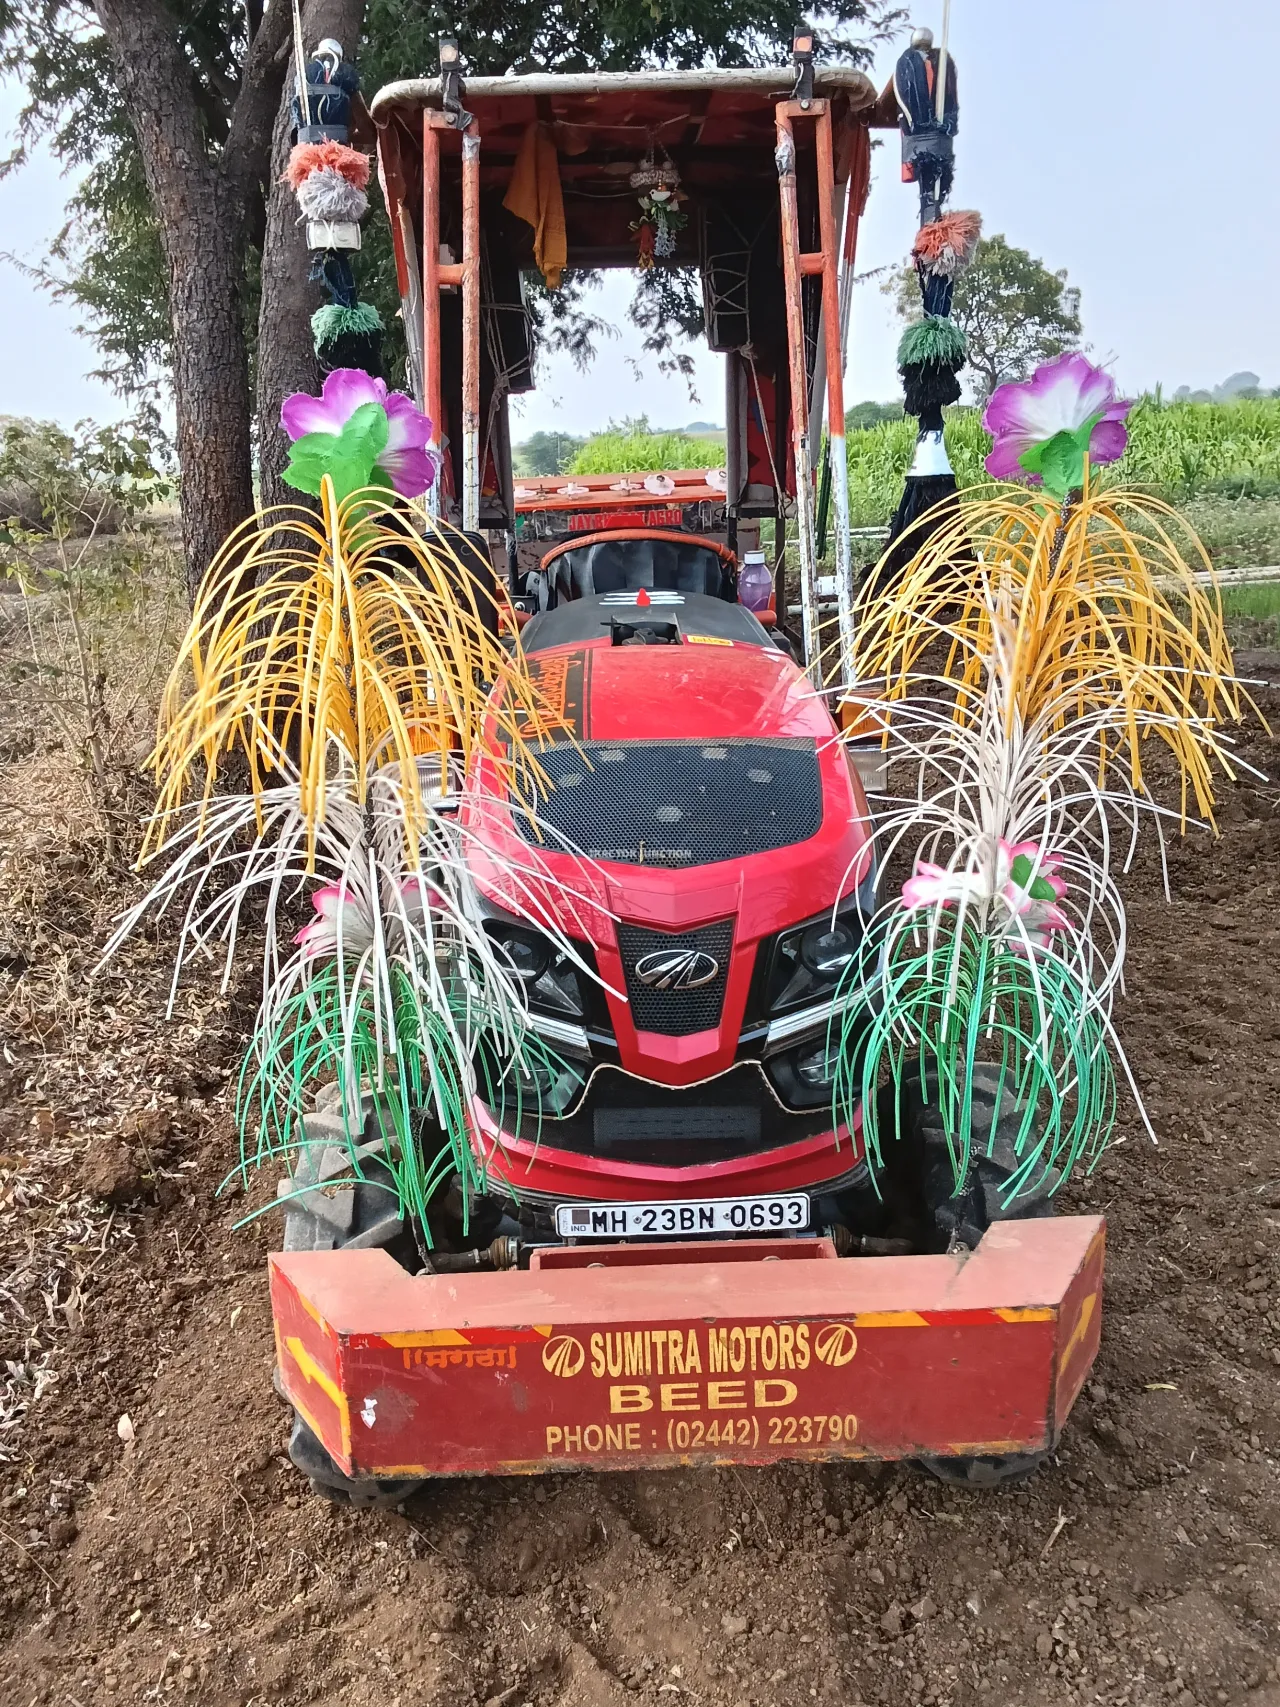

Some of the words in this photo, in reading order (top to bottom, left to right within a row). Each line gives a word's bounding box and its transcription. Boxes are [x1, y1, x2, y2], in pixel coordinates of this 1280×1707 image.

[568, 514, 593, 531] JAY
[648, 509, 682, 526] AGRO
[592, 1210, 627, 1233] MH
[641, 1206, 715, 1232] 23BN
[730, 1201, 802, 1228] 0693
[590, 1328, 703, 1378] SUMITRA
[708, 1323, 811, 1373] MOTORS
[609, 1379, 798, 1414] BEED
[546, 1423, 642, 1453] PHONE
[666, 1415, 760, 1452] (02442)
[768, 1414, 858, 1445] 223790
